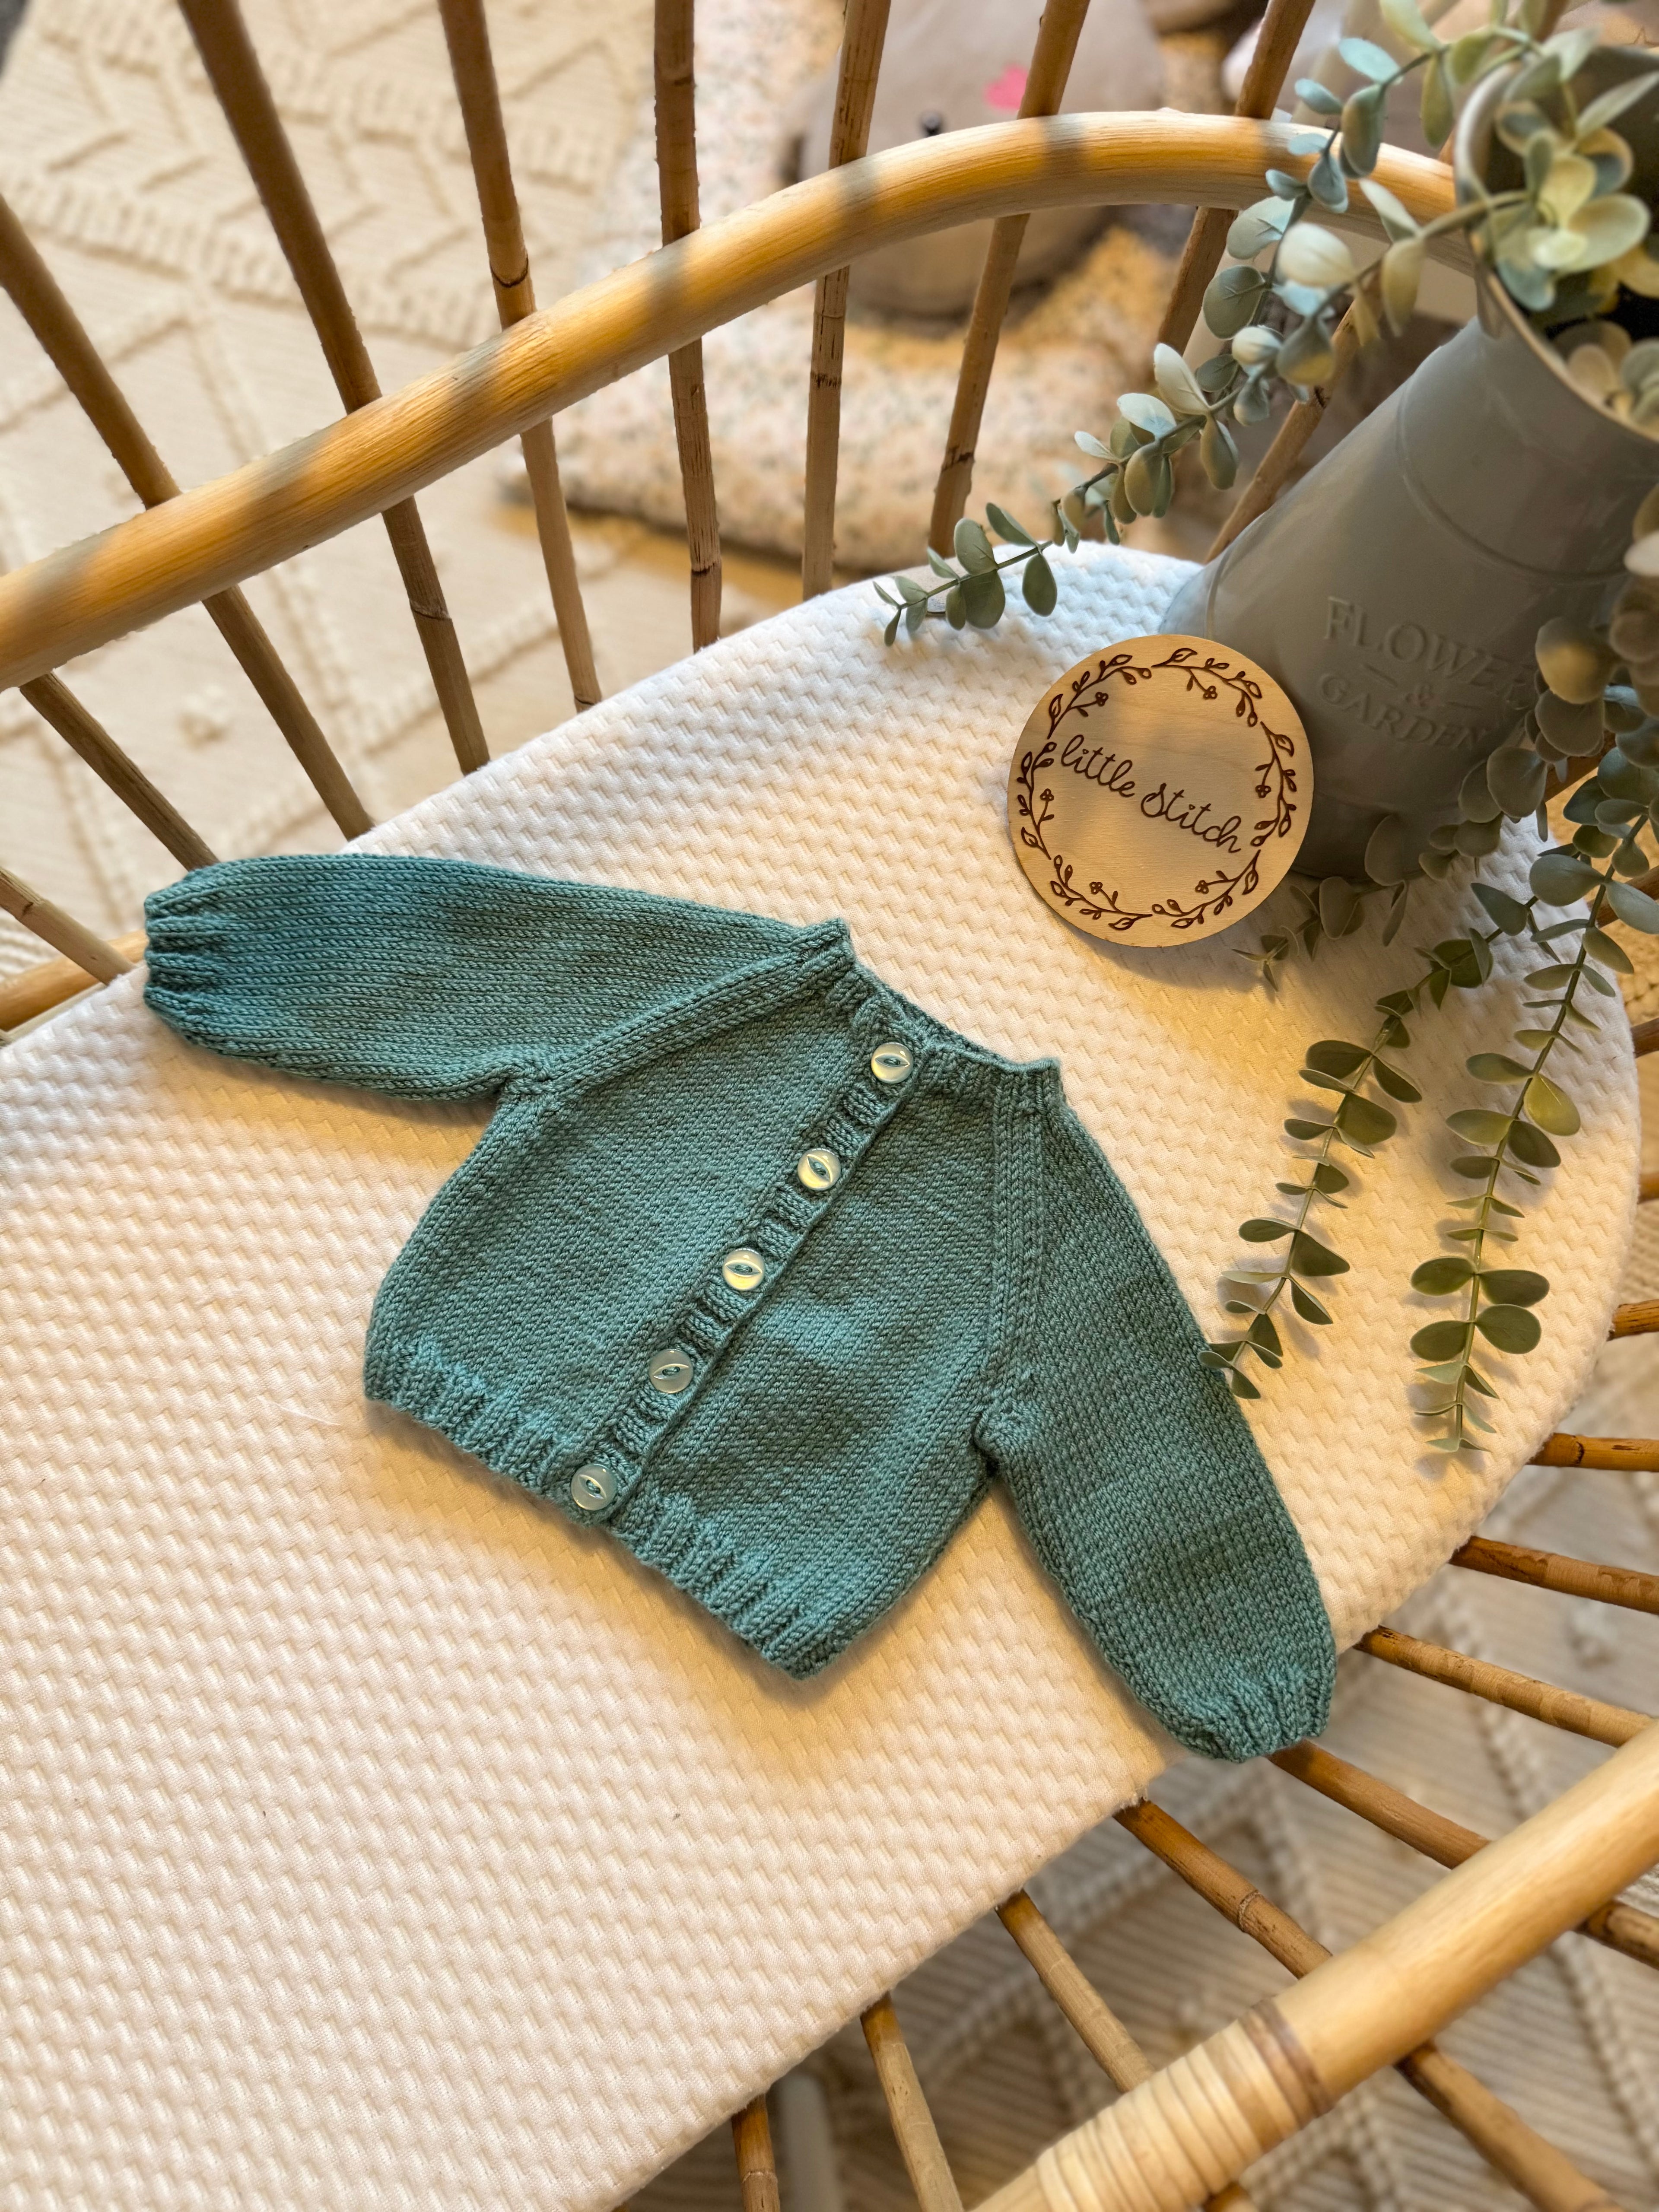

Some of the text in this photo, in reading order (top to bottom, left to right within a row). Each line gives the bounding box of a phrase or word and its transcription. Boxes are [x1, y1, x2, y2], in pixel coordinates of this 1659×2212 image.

[1318, 673, 1491, 749] GARDEN
[1403, 681, 1436, 710] &
[1061, 734, 1135, 798] little
